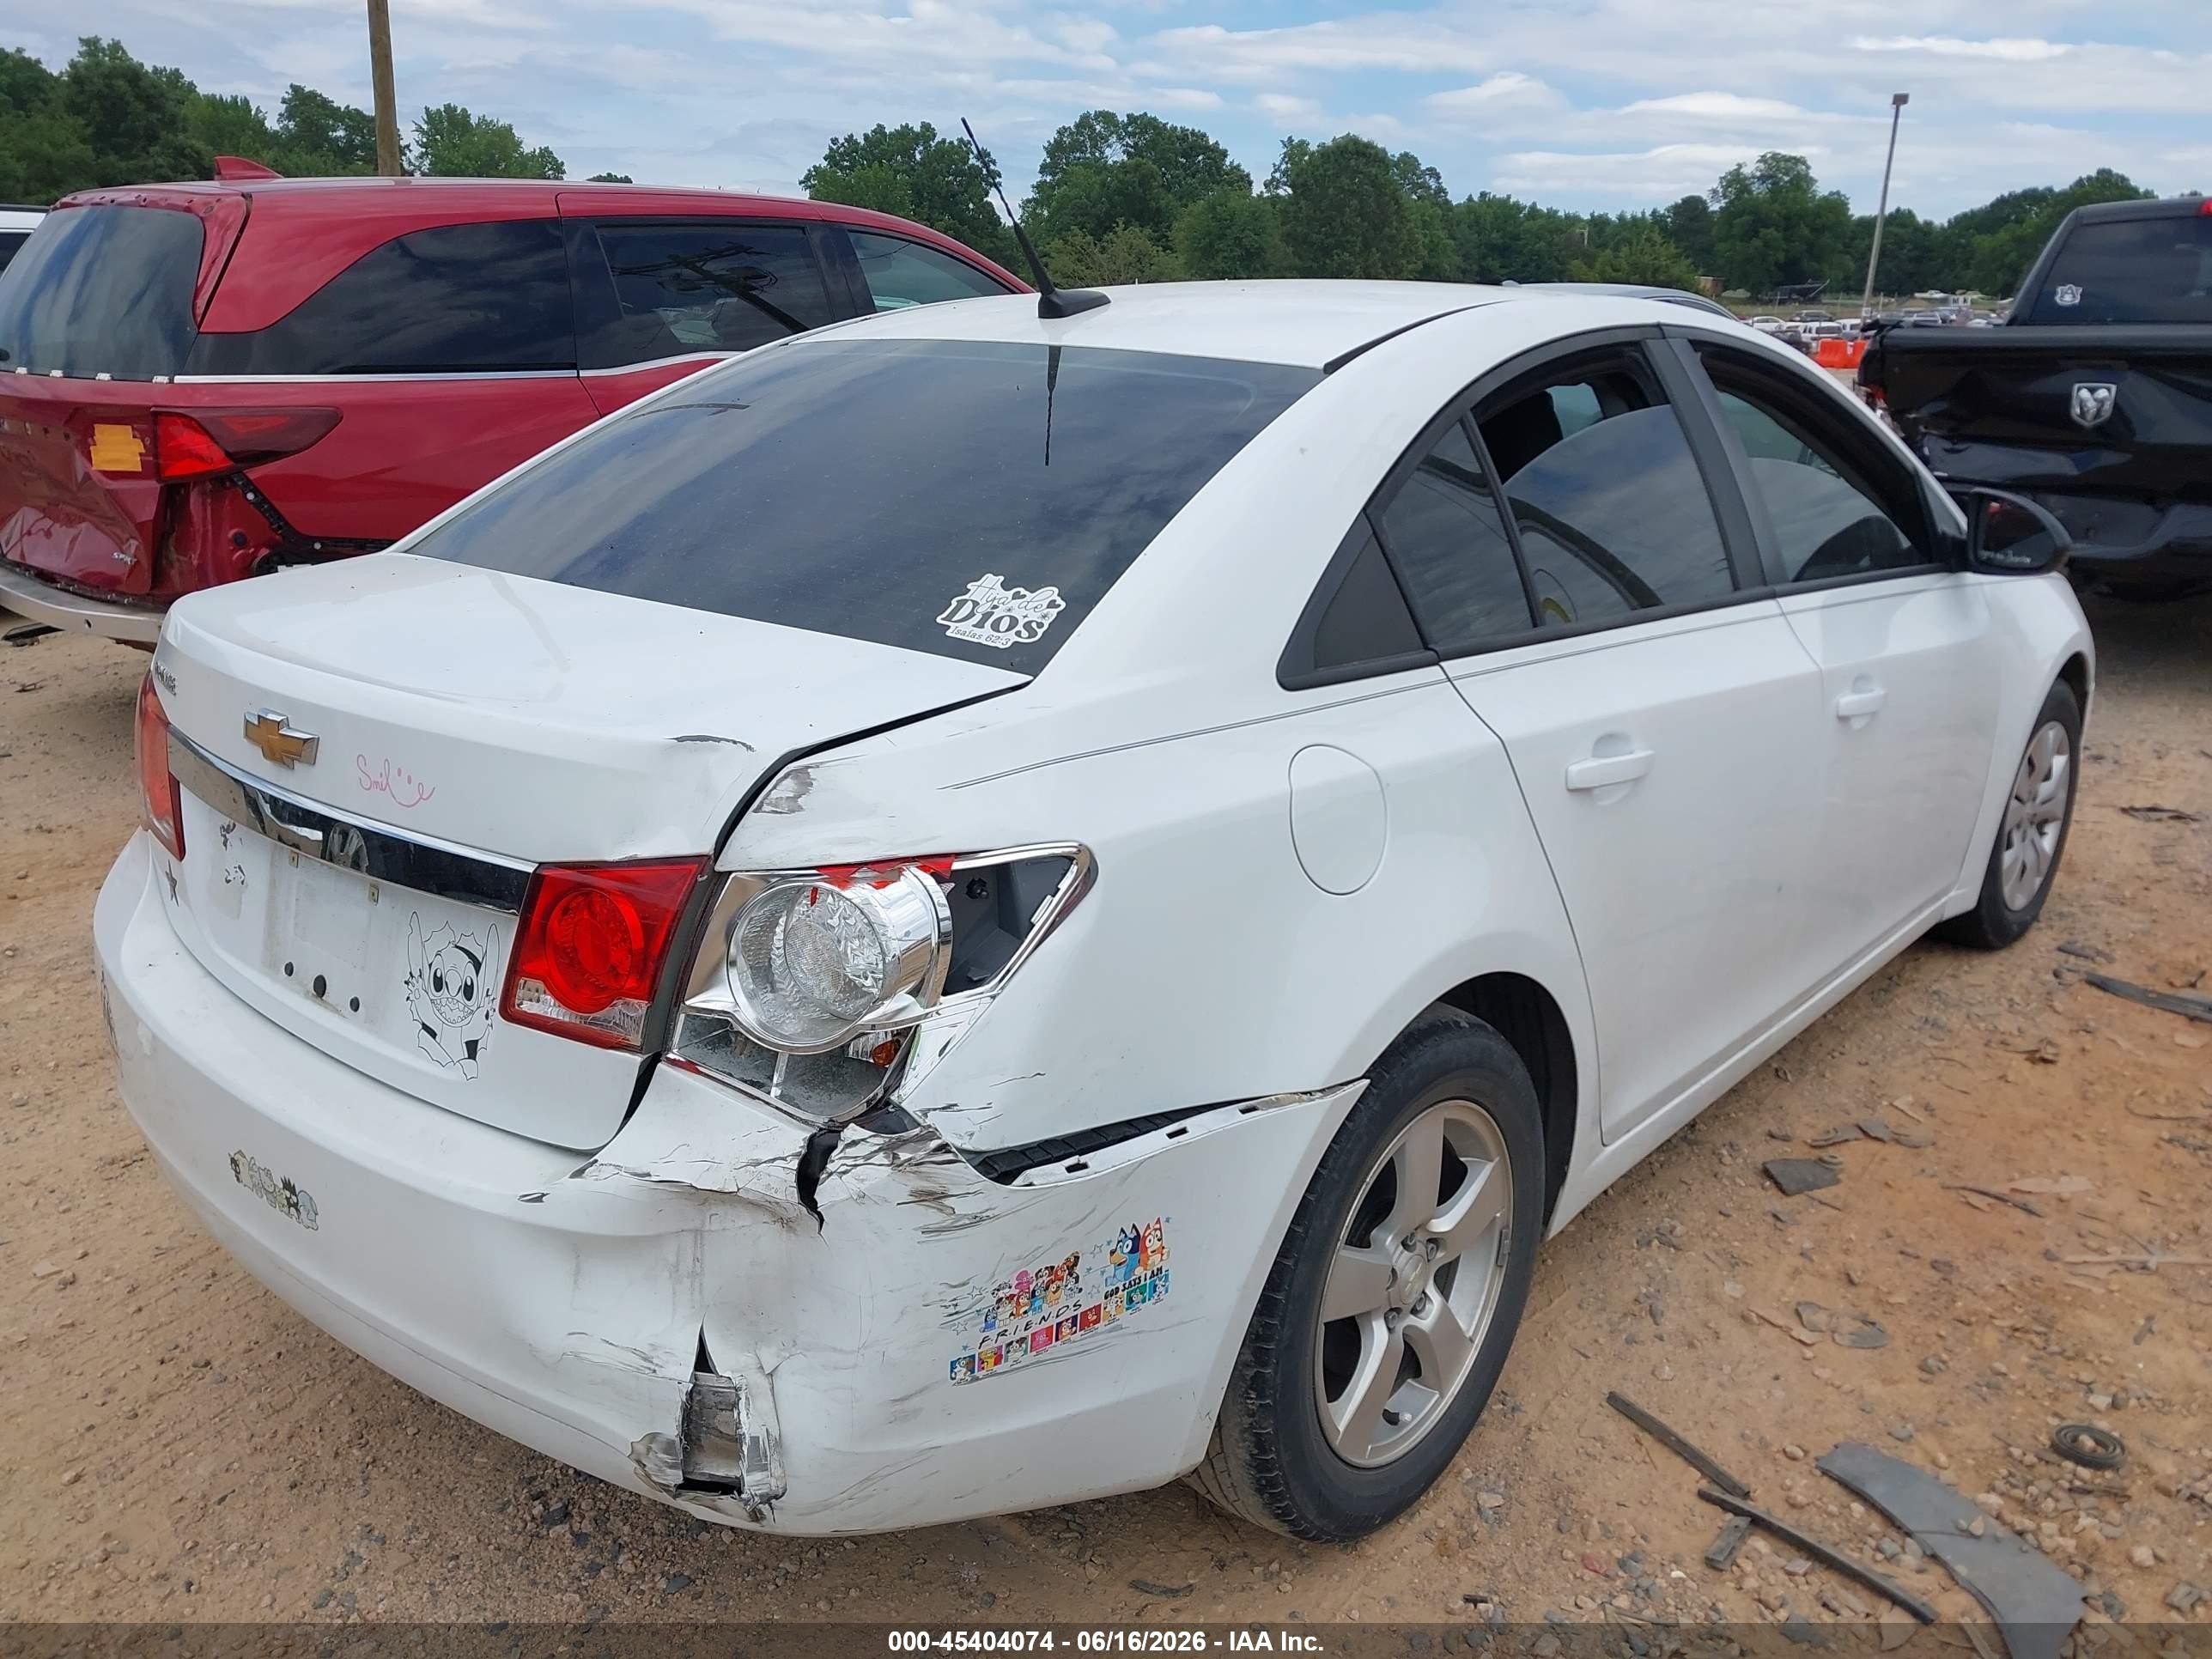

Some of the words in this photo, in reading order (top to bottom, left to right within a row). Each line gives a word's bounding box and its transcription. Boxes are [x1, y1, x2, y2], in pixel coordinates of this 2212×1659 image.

[941, 599, 1045, 640] Dios
[984, 634, 1012, 647] 62:3
[356, 754, 436, 808] Smile
[1103, 1285, 1120, 1300] GOD
[1121, 1275, 1142, 1292] SAYS
[1149, 1265, 1164, 1279] AM
